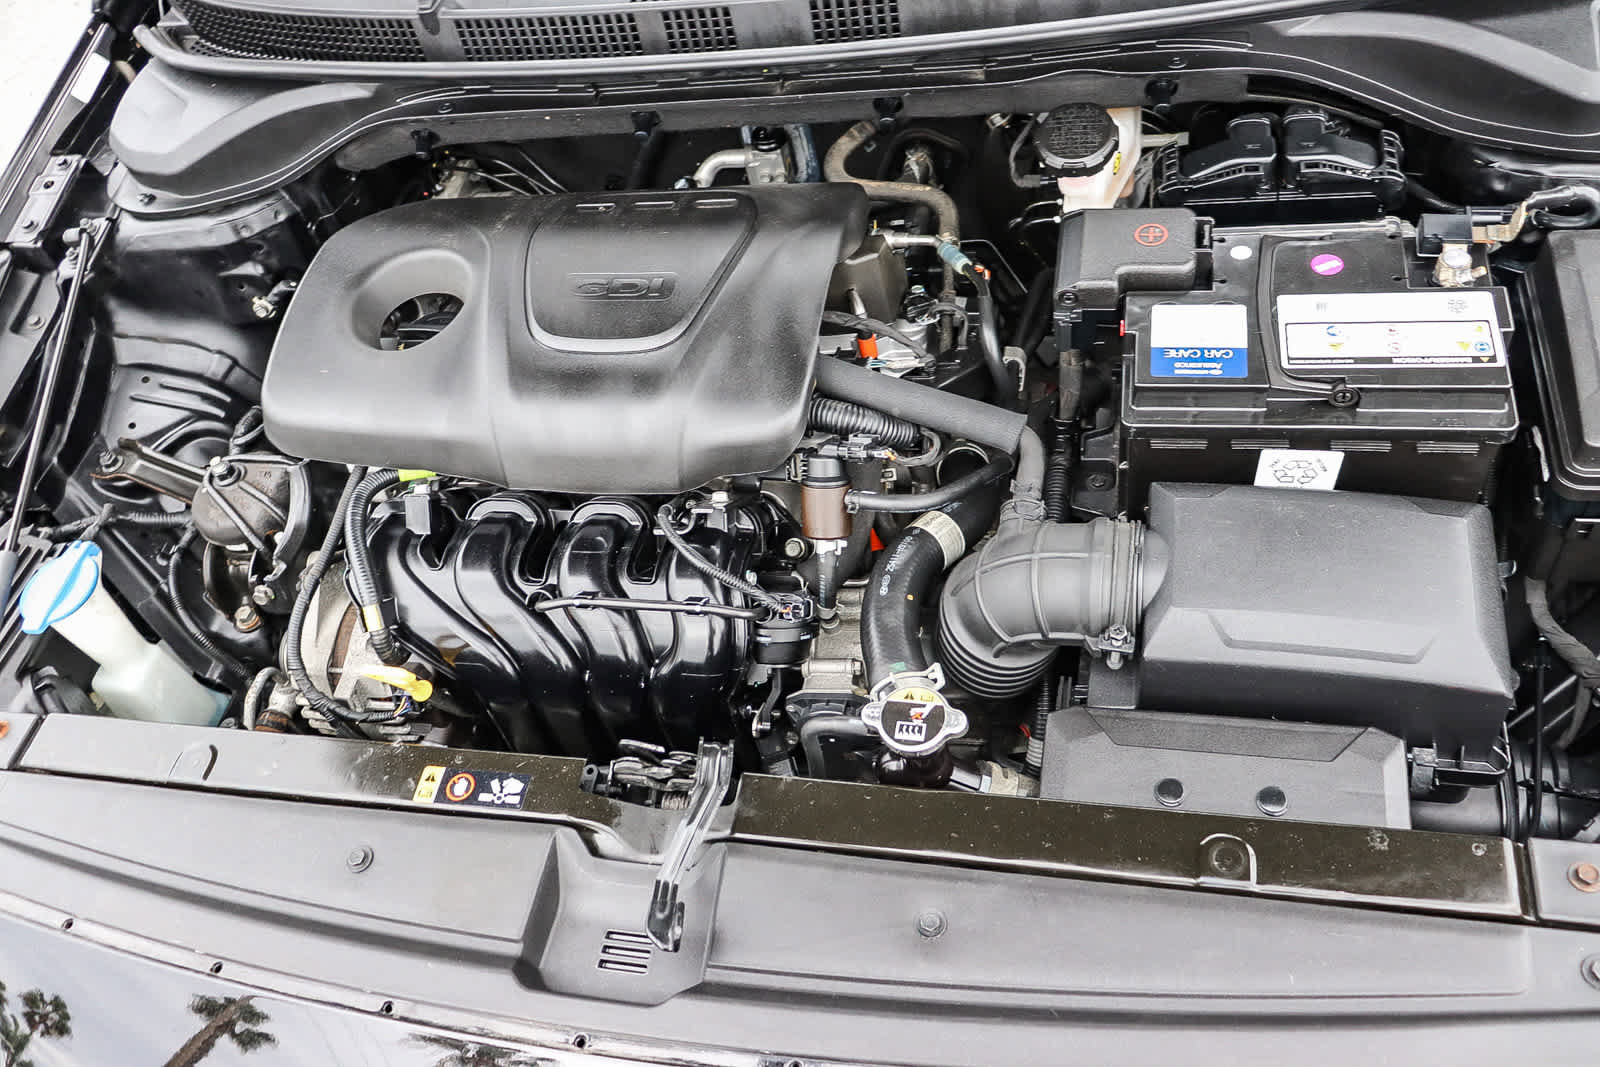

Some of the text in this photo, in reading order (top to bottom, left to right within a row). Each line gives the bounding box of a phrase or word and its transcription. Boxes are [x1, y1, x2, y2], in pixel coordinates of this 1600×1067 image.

[572, 277, 665, 297] GDI
[1163, 349, 1233, 358] CAR CARE
